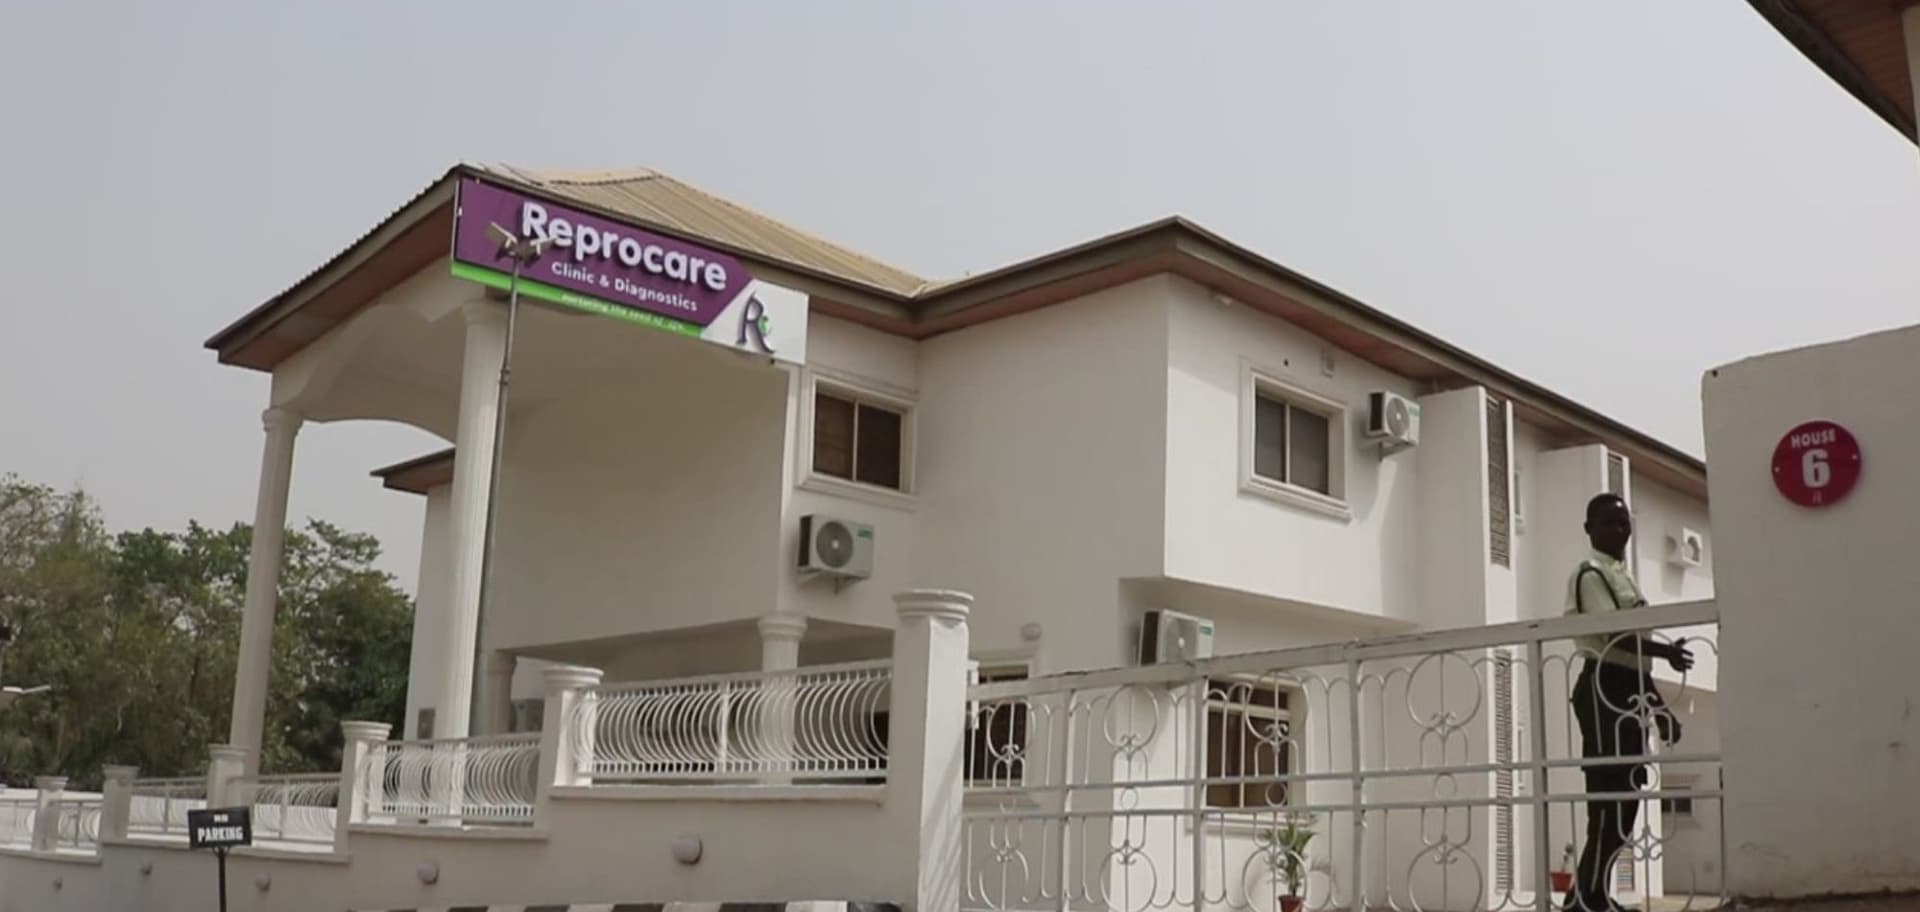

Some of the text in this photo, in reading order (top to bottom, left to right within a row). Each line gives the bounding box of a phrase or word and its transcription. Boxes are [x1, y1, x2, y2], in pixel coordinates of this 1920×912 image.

[522, 202, 727, 290] Reprocare
[551, 261, 698, 311] Clinic & Diagnostics
[1790, 429, 1836, 448] HOUSE
[1802, 448, 1830, 488] 6
[197, 826, 243, 843] PARKING
